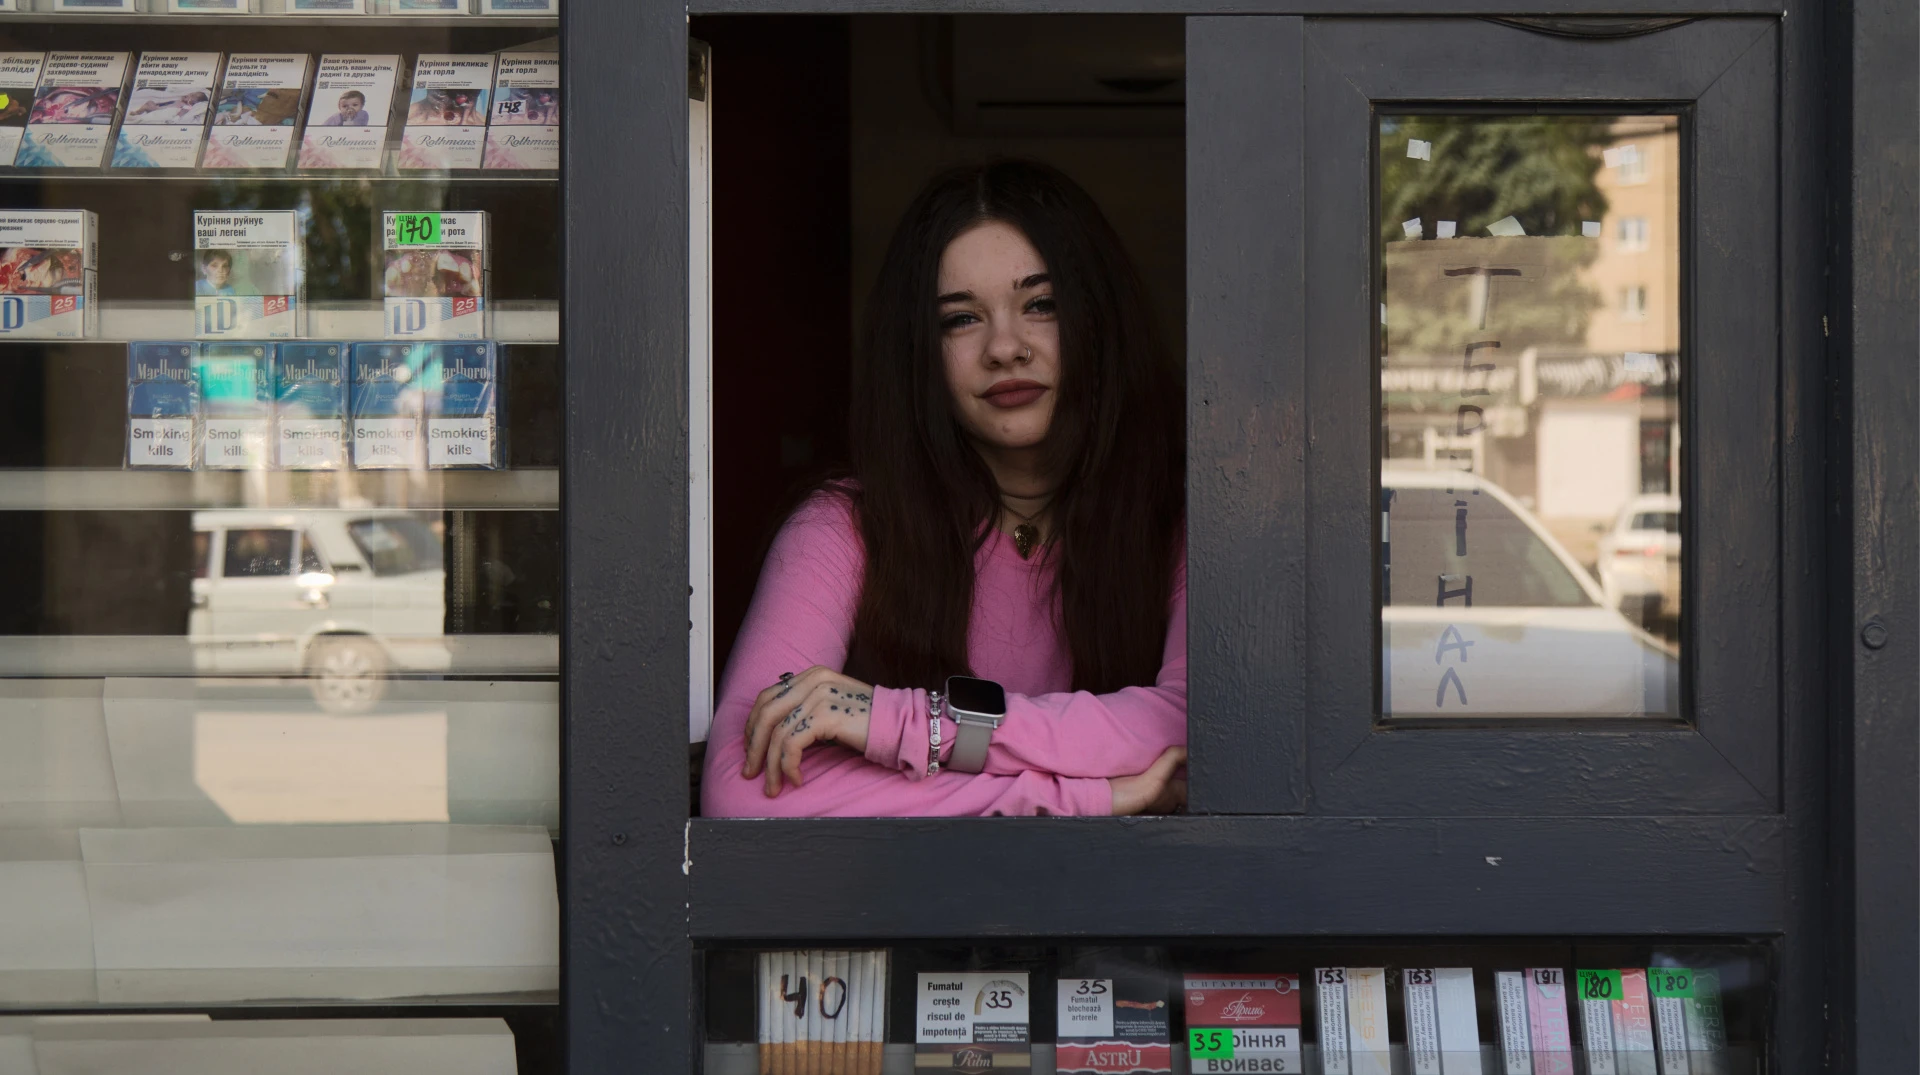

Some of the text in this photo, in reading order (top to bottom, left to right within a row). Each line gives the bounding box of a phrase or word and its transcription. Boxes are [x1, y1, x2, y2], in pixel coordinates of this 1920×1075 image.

[419, 60, 450, 68] Куріння
[498, 101, 522, 114] 148
[37, 133, 99, 145] Rothmans
[134, 134, 193, 146] Rothmans
[223, 134, 284, 147] Rothmans
[317, 135, 378, 147] Rothmans
[417, 135, 476, 147] Rothmans
[502, 134, 559, 147] Rothmans
[197, 216, 264, 226] Куріння руйнує
[197, 228, 247, 237] ваші легені
[399, 216, 432, 243] 170
[54, 297, 74, 310] 25
[267, 297, 286, 310] 25
[456, 298, 474, 311] 25
[0, 297, 24, 332] D
[205, 298, 237, 334] LD
[394, 299, 426, 334] LD
[137, 359, 190, 380] Marlboro
[285, 359, 338, 380] Marlboro
[134, 428, 190, 441] Smoking
[283, 429, 340, 441] Smoking
[357, 429, 413, 440] Smoking
[431, 428, 488, 440] Smoking
[148, 445, 174, 456] kills
[224, 446, 249, 456] kills
[298, 446, 324, 456] kills
[372, 445, 397, 455] kills
[447, 445, 472, 455] kills
[1319, 968, 1344, 984] 153
[1408, 968, 1432, 985] 153
[1535, 970, 1556, 985] 191
[928, 982, 963, 991] Fumatul
[1076, 980, 1107, 995] 35
[1585, 977, 1612, 999] 180
[1656, 976, 1688, 992] 180
[780, 974, 846, 1019] 40
[933, 997, 960, 1008] crește
[986, 991, 1012, 1009] 35
[1360, 974, 1375, 1040] HEETS
[927, 1012, 966, 1021] riscul de
[1703, 992, 1722, 1051] TEREA
[922, 1027, 967, 1039] impotență
[1548, 1005, 1568, 1073] TEREA
[1194, 1032, 1222, 1052] 35
